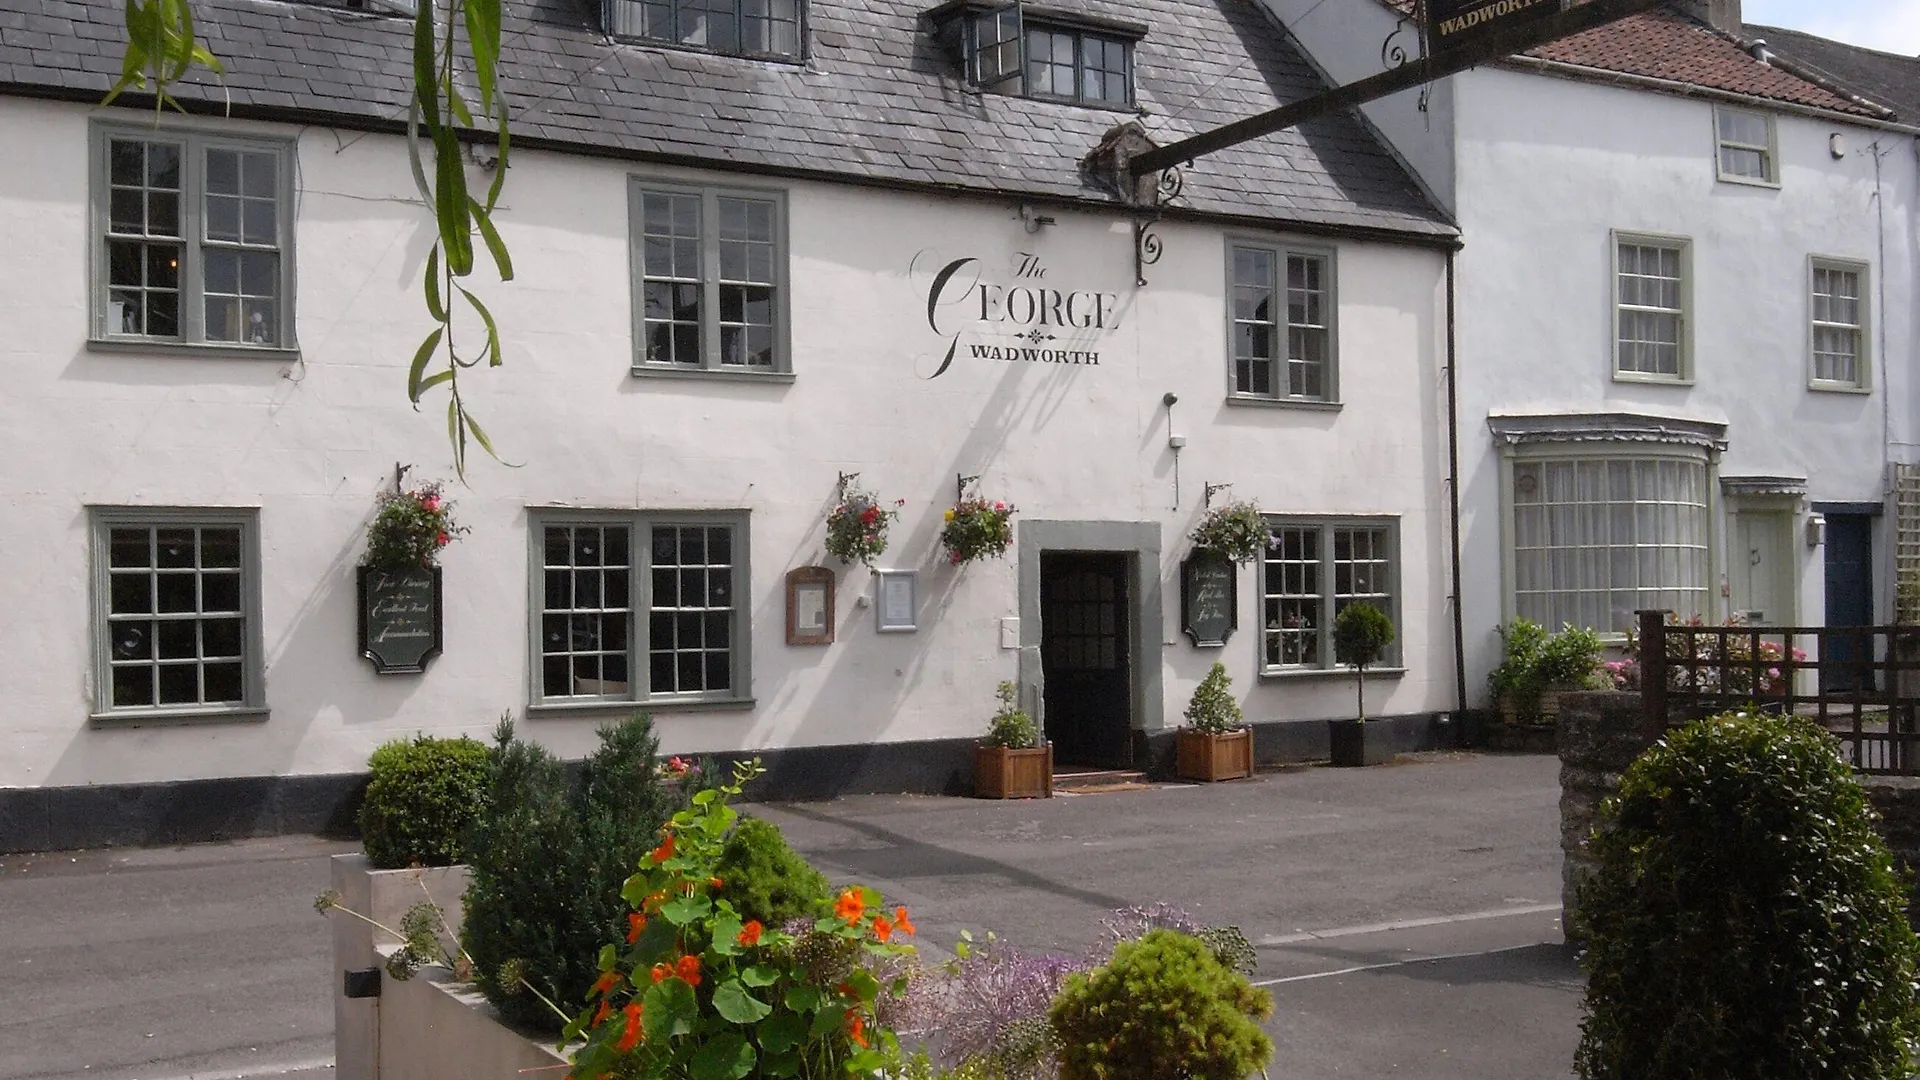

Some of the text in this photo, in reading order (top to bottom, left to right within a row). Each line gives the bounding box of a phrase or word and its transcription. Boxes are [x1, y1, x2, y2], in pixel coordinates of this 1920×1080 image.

[1439, 0, 1543, 36] WADWOR
[1010, 252, 1048, 279] The
[909, 248, 1119, 380] GEORGE
[970, 344, 1100, 366] WADWORTH
